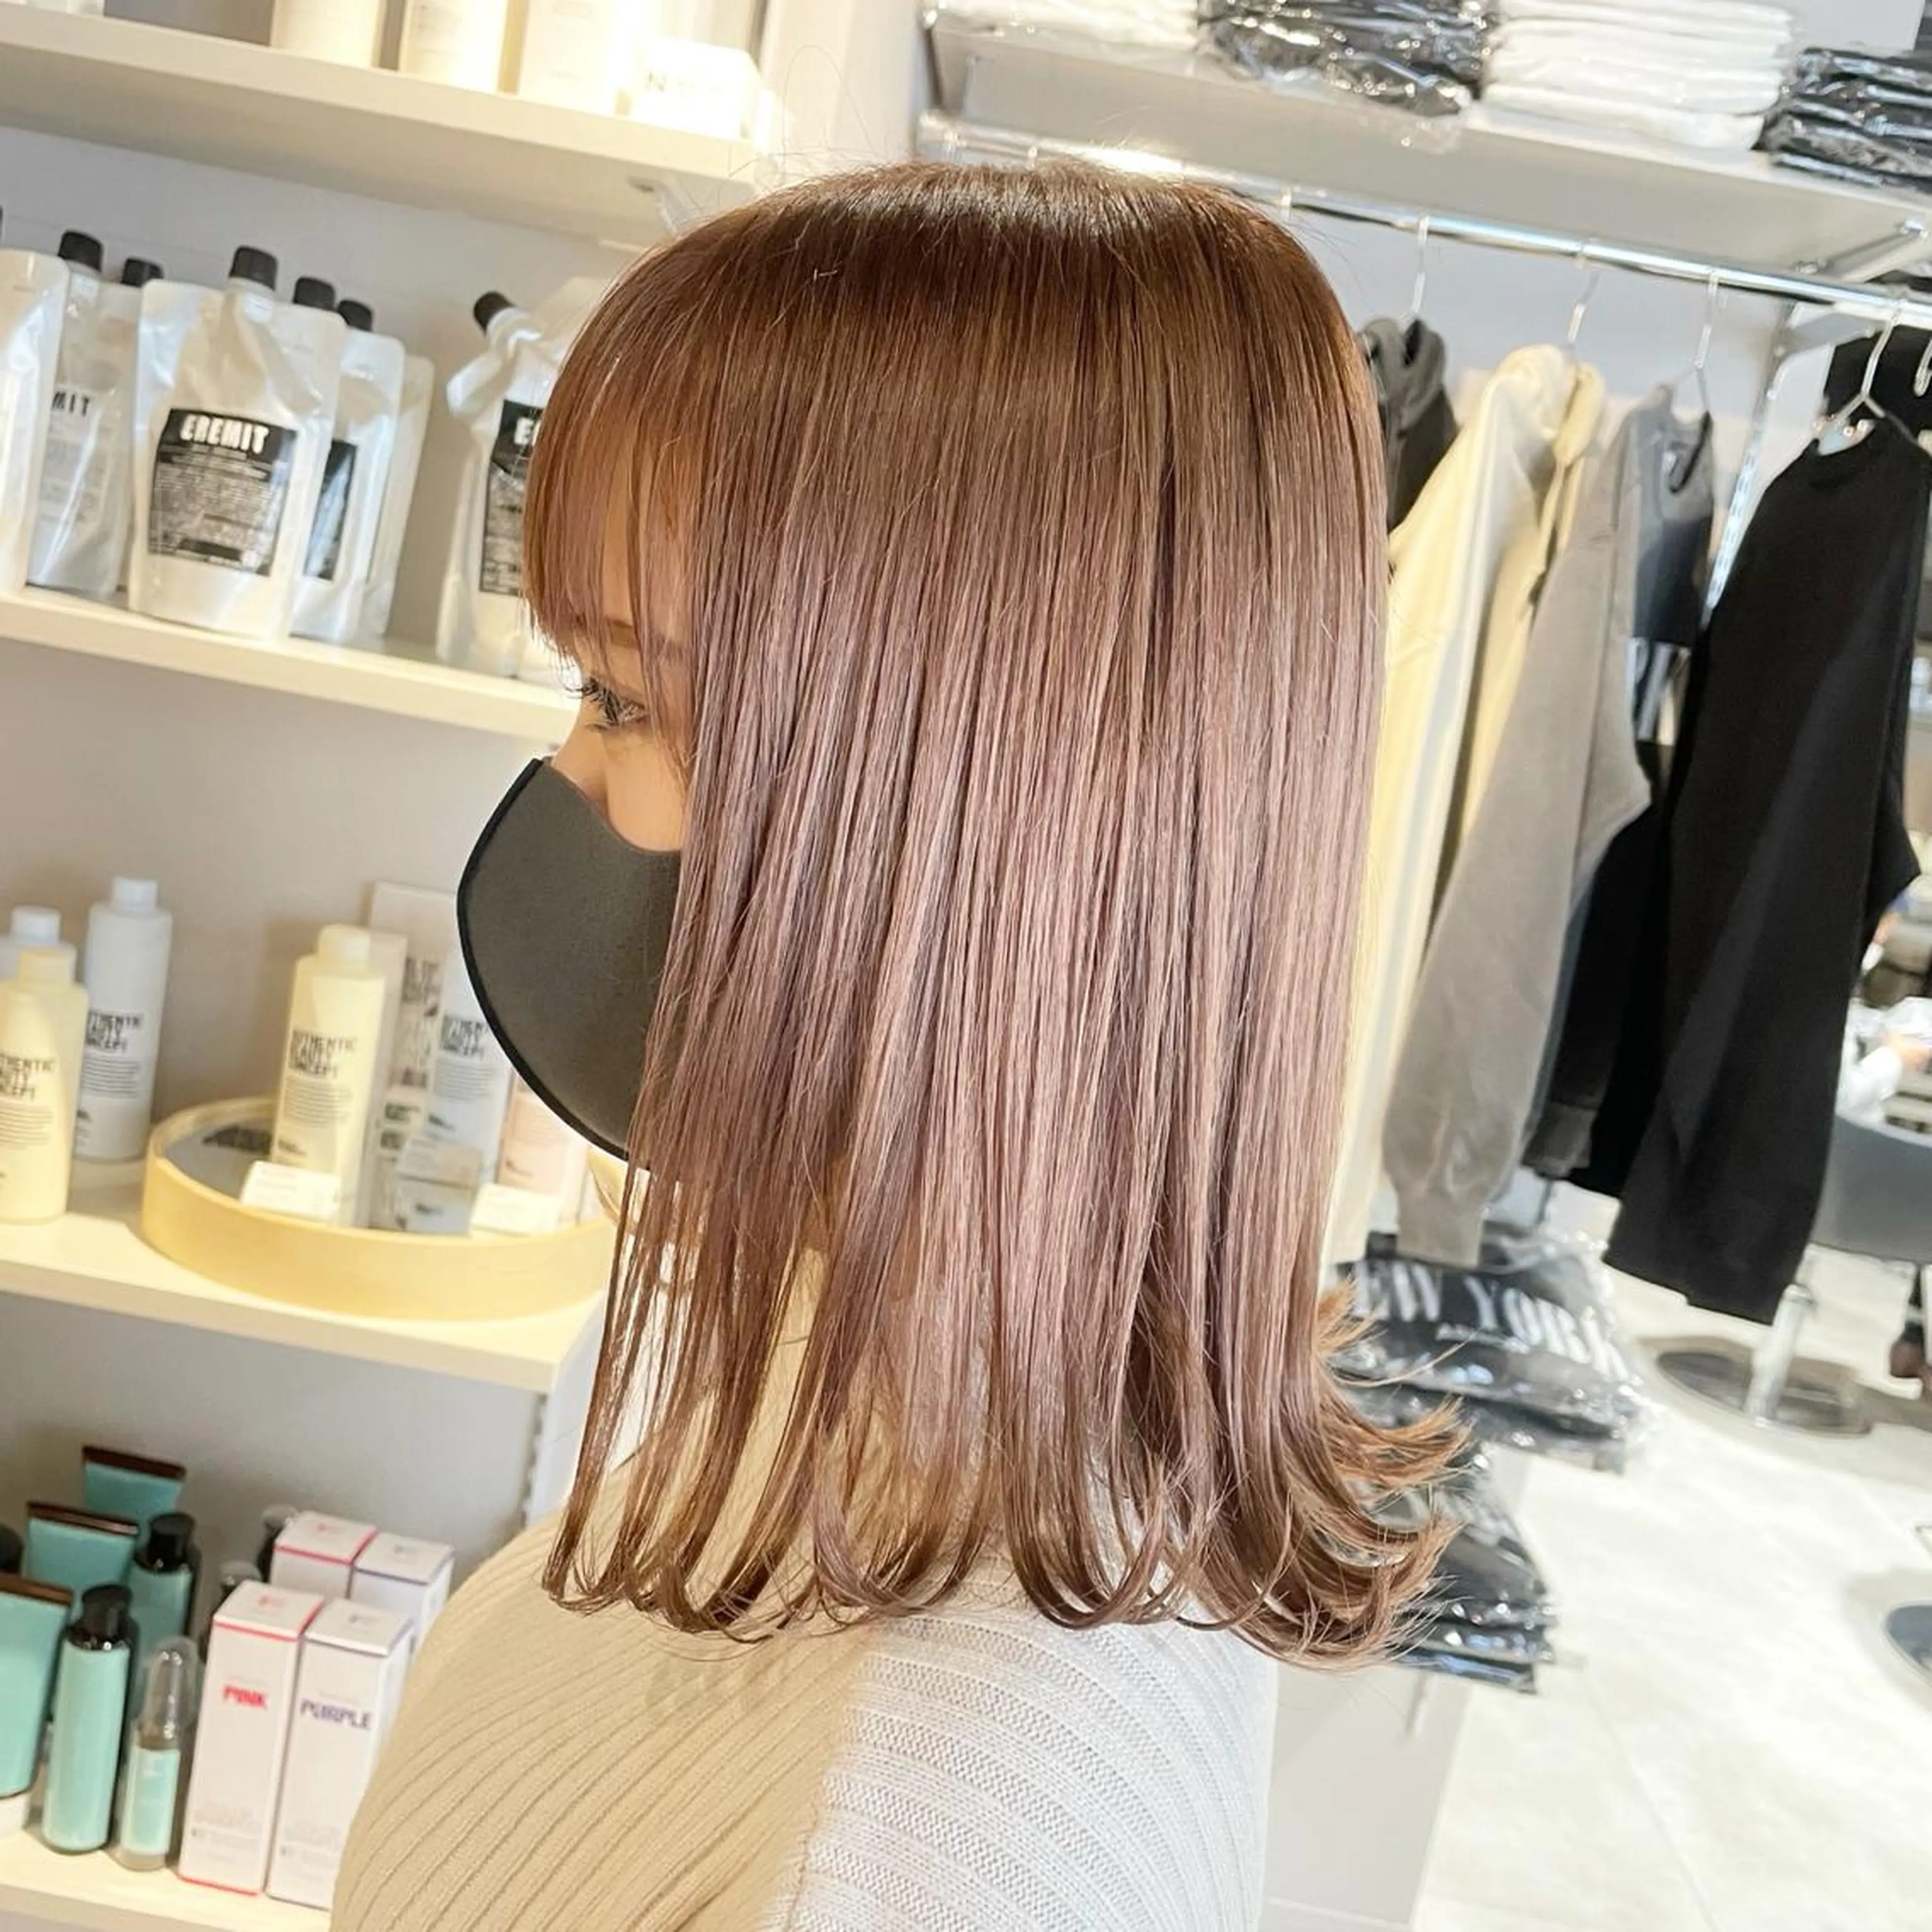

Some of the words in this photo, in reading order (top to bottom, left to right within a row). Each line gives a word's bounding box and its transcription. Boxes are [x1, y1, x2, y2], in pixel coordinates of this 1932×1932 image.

[52, 391, 90, 418] MIT
[180, 414, 270, 454] EREMIT
[222, 1684, 268, 1710] PINK
[300, 1698, 371, 1731] PURPLE
